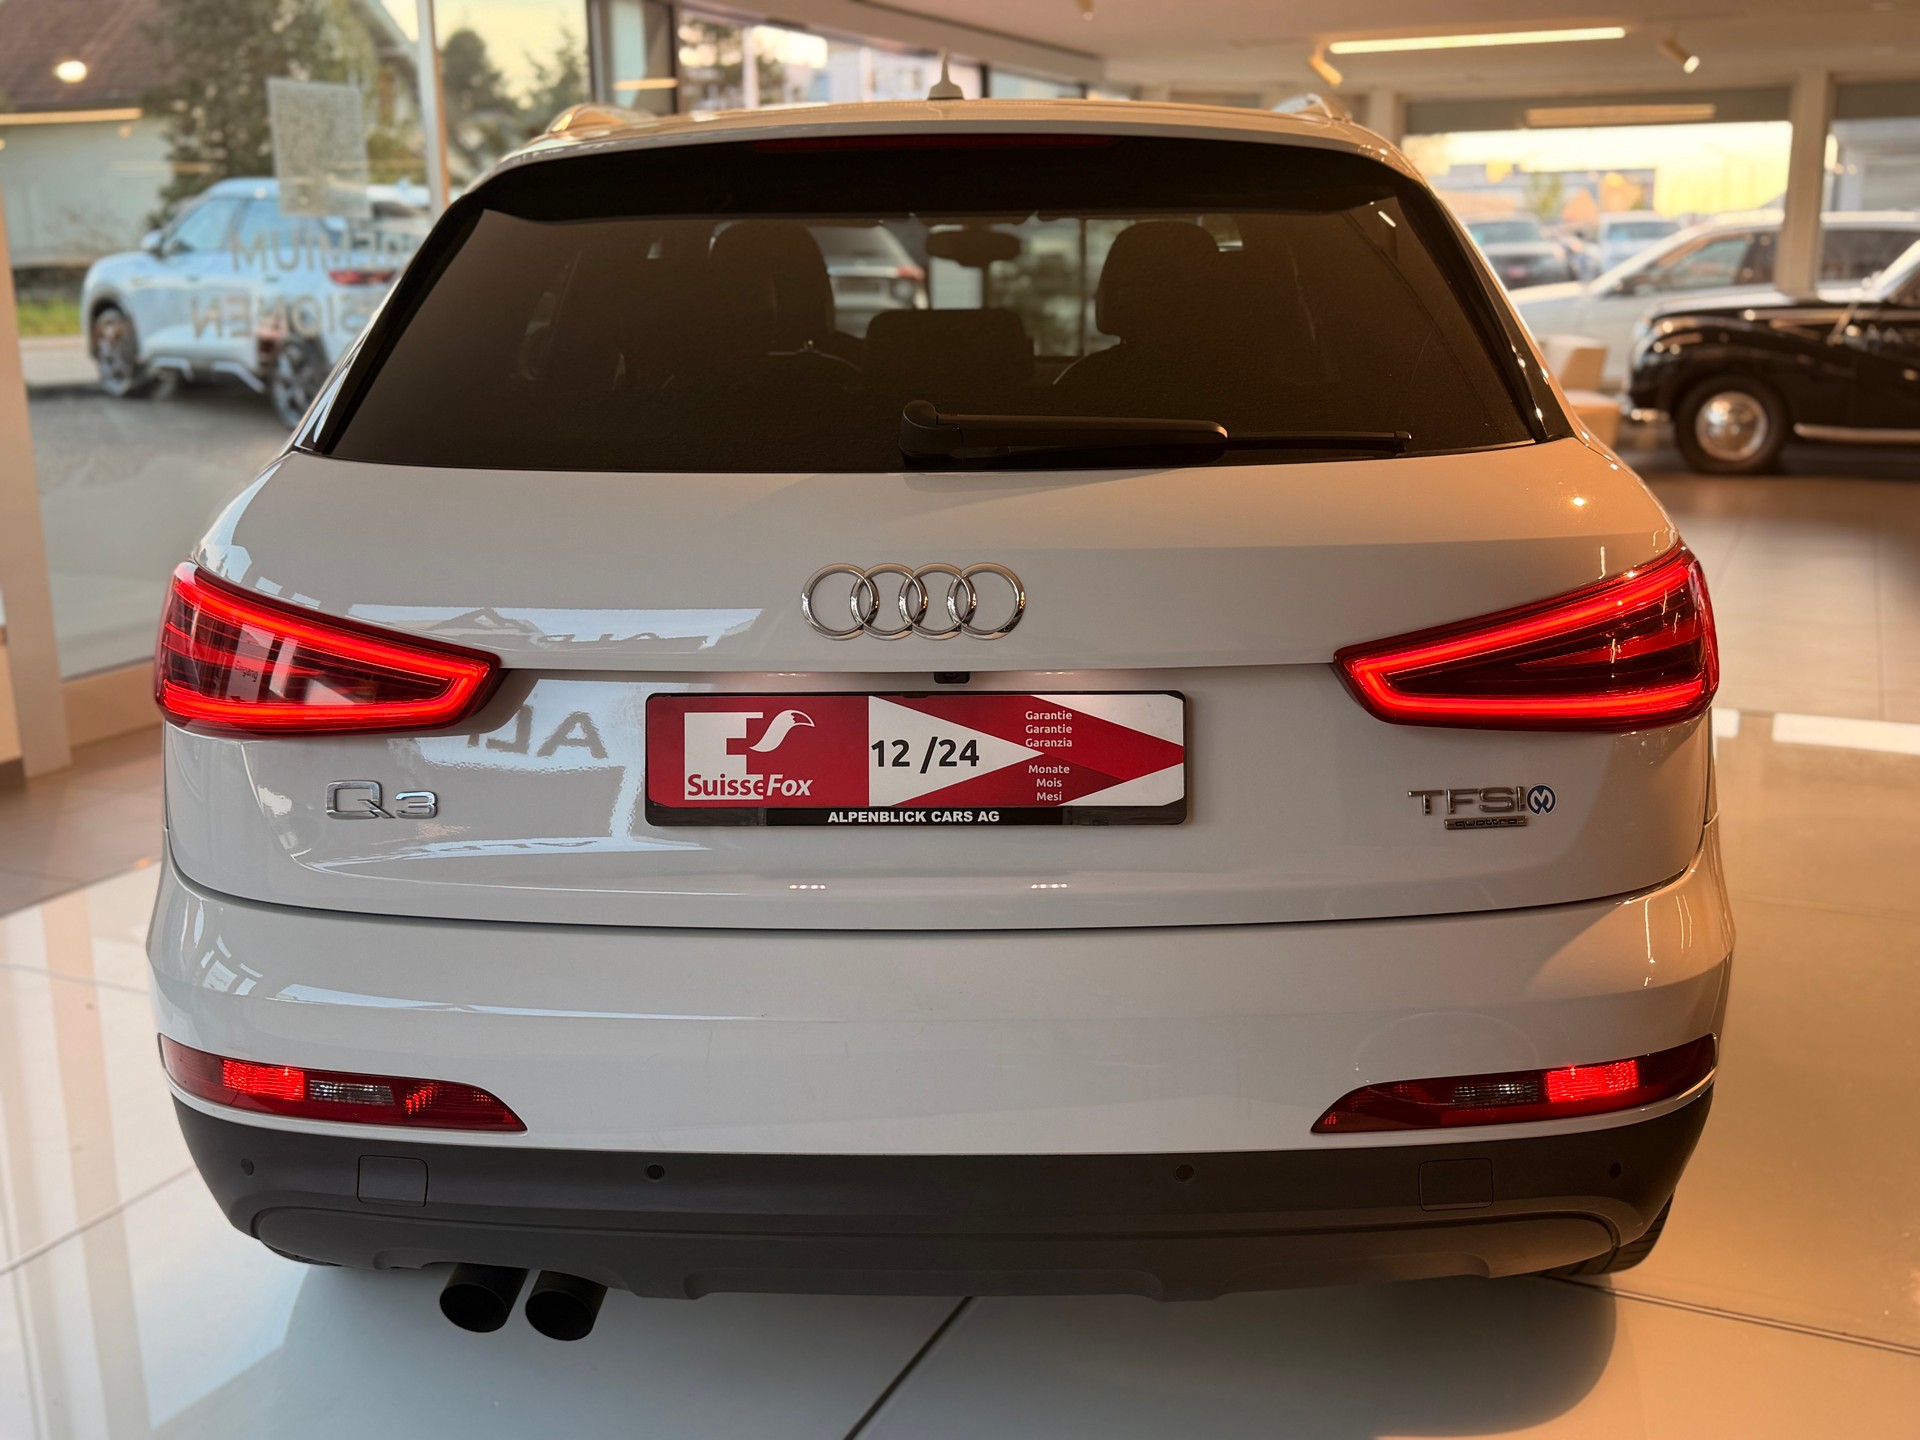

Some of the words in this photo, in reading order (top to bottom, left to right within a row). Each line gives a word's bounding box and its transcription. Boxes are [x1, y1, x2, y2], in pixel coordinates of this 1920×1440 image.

[1025, 710, 1073, 720] Garantie
[1025, 724, 1073, 734] Garantie
[1025, 737, 1073, 747] Garanzia
[871, 739, 911, 768] 12
[1028, 764, 1070, 774] Monate
[1036, 777, 1063, 788] Mois
[1036, 791, 1063, 801] Mesi
[1407, 785, 1527, 816] TFSI
[827, 811, 927, 823] ALPENBLICK
[931, 811, 973, 823] CARS
[977, 811, 1001, 823] AG
[1454, 817, 1519, 829] quattro
